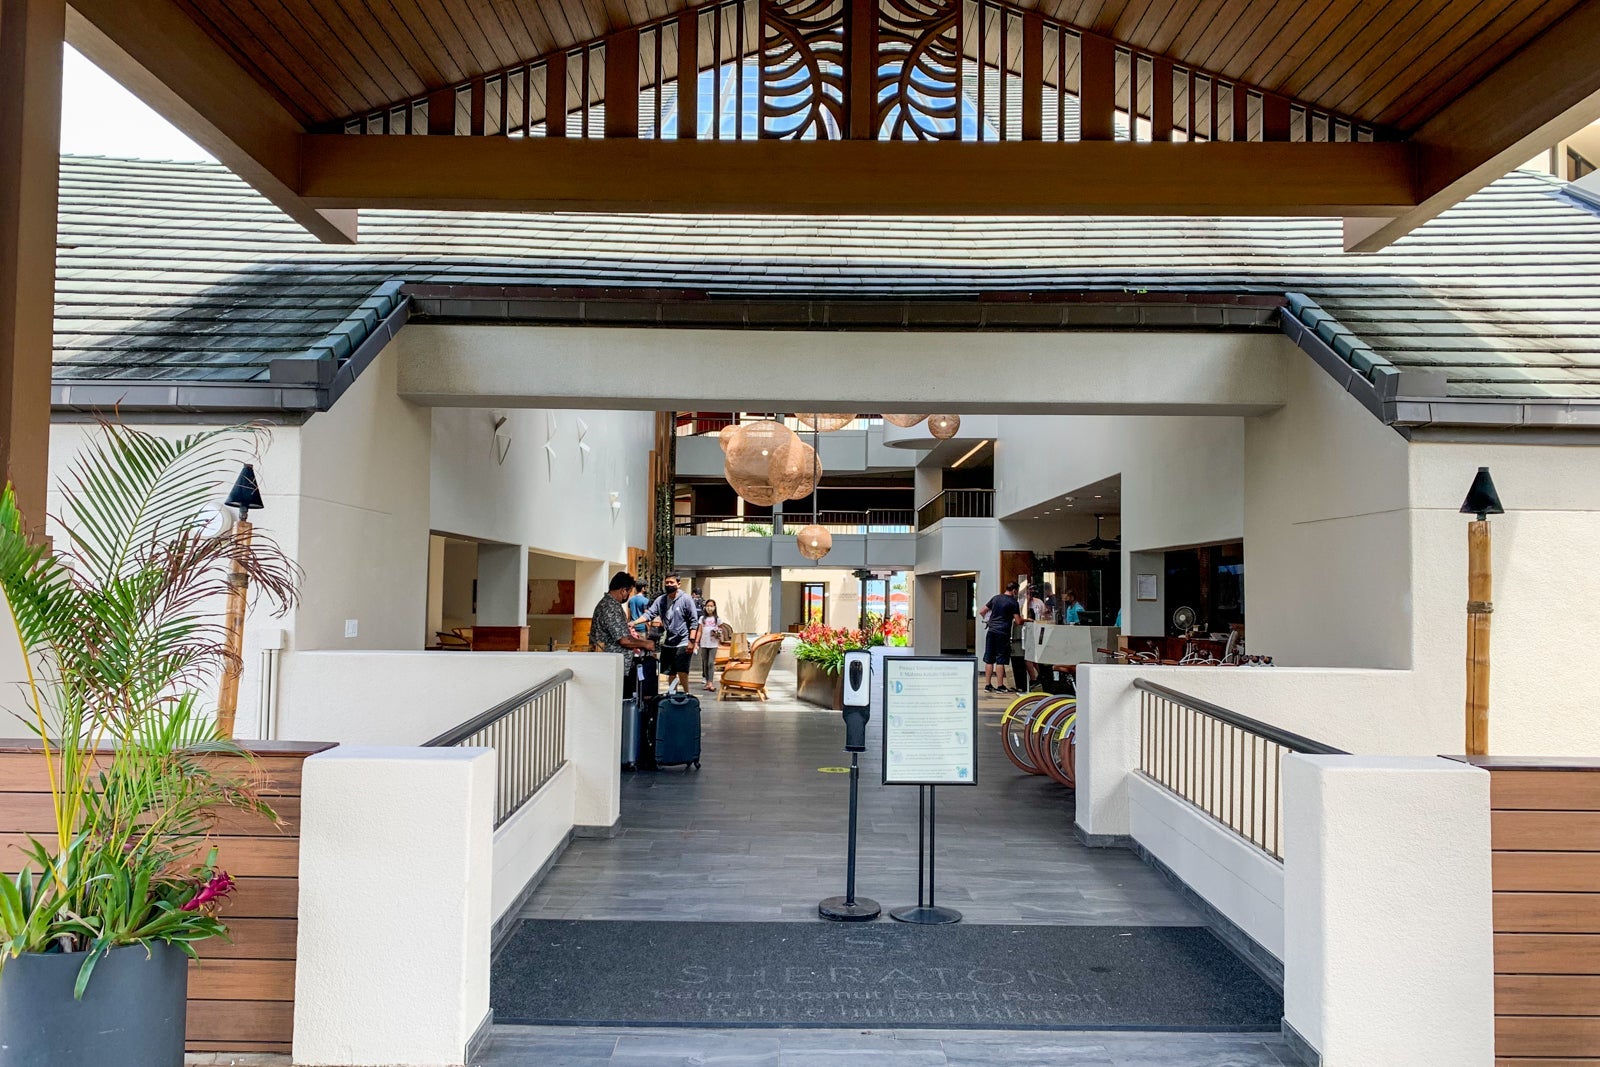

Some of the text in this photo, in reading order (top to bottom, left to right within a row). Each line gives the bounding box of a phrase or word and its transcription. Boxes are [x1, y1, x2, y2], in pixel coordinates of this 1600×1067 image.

[679, 965, 1077, 986] SHERATON
[893, 987, 990, 1002] Beach
[1002, 989, 1106, 1003] Reort
